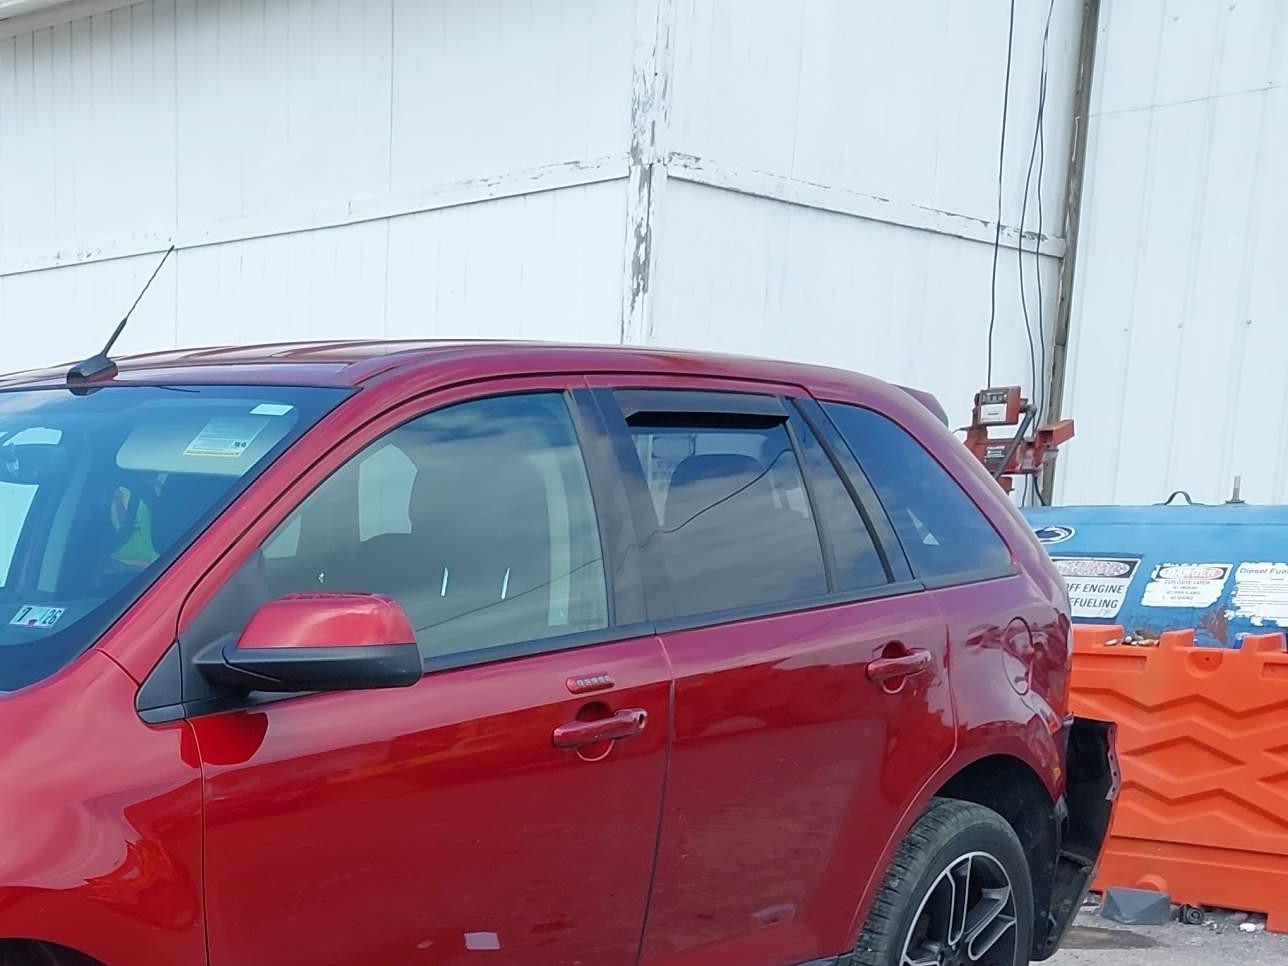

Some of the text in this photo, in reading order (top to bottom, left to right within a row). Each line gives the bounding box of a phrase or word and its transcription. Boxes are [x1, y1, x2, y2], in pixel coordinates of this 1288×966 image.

[1166, 567, 1217, 579] DANGER
[1082, 583, 1125, 594] ENGINE
[1071, 597, 1118, 609] FUELING
[16, 607, 33, 622] 7
